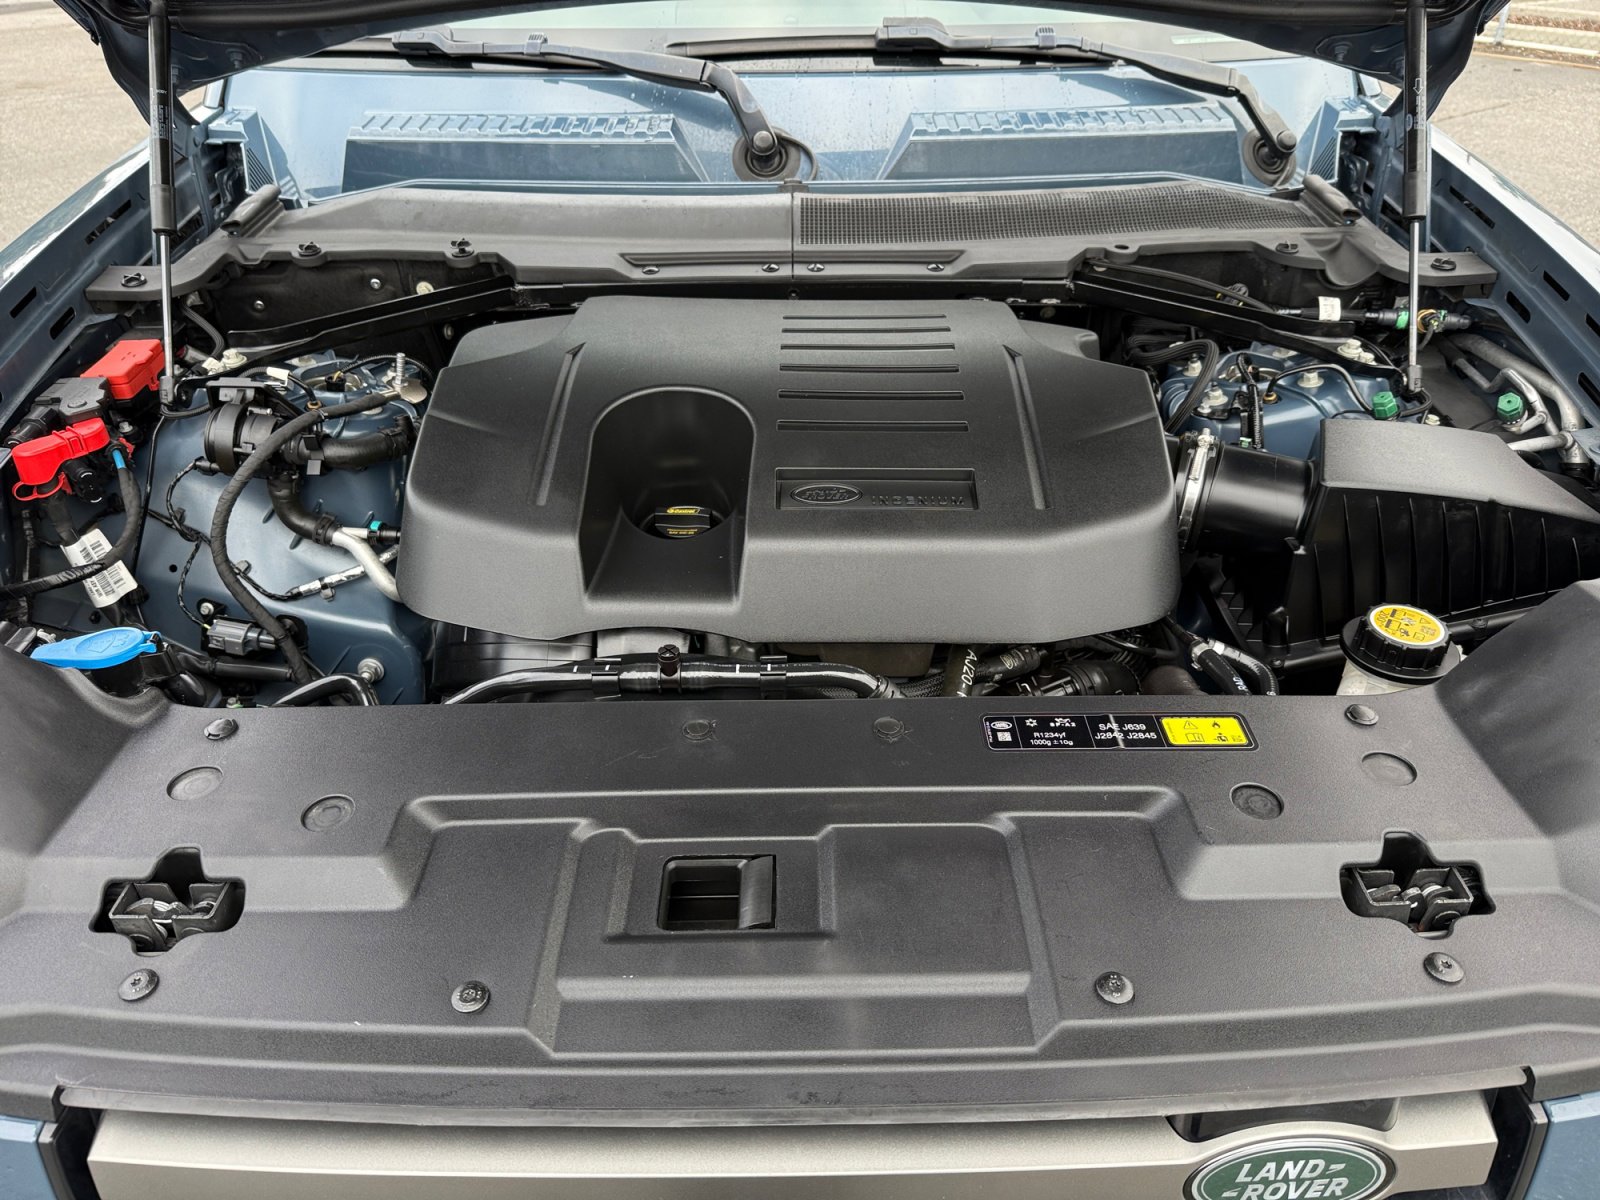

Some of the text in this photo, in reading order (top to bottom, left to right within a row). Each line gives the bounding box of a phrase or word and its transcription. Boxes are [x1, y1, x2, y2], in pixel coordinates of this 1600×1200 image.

[871, 495, 965, 505] INGENIUM
[1234, 1158, 1326, 1183] LAND
[1241, 1177, 1349, 1200] ROVER
